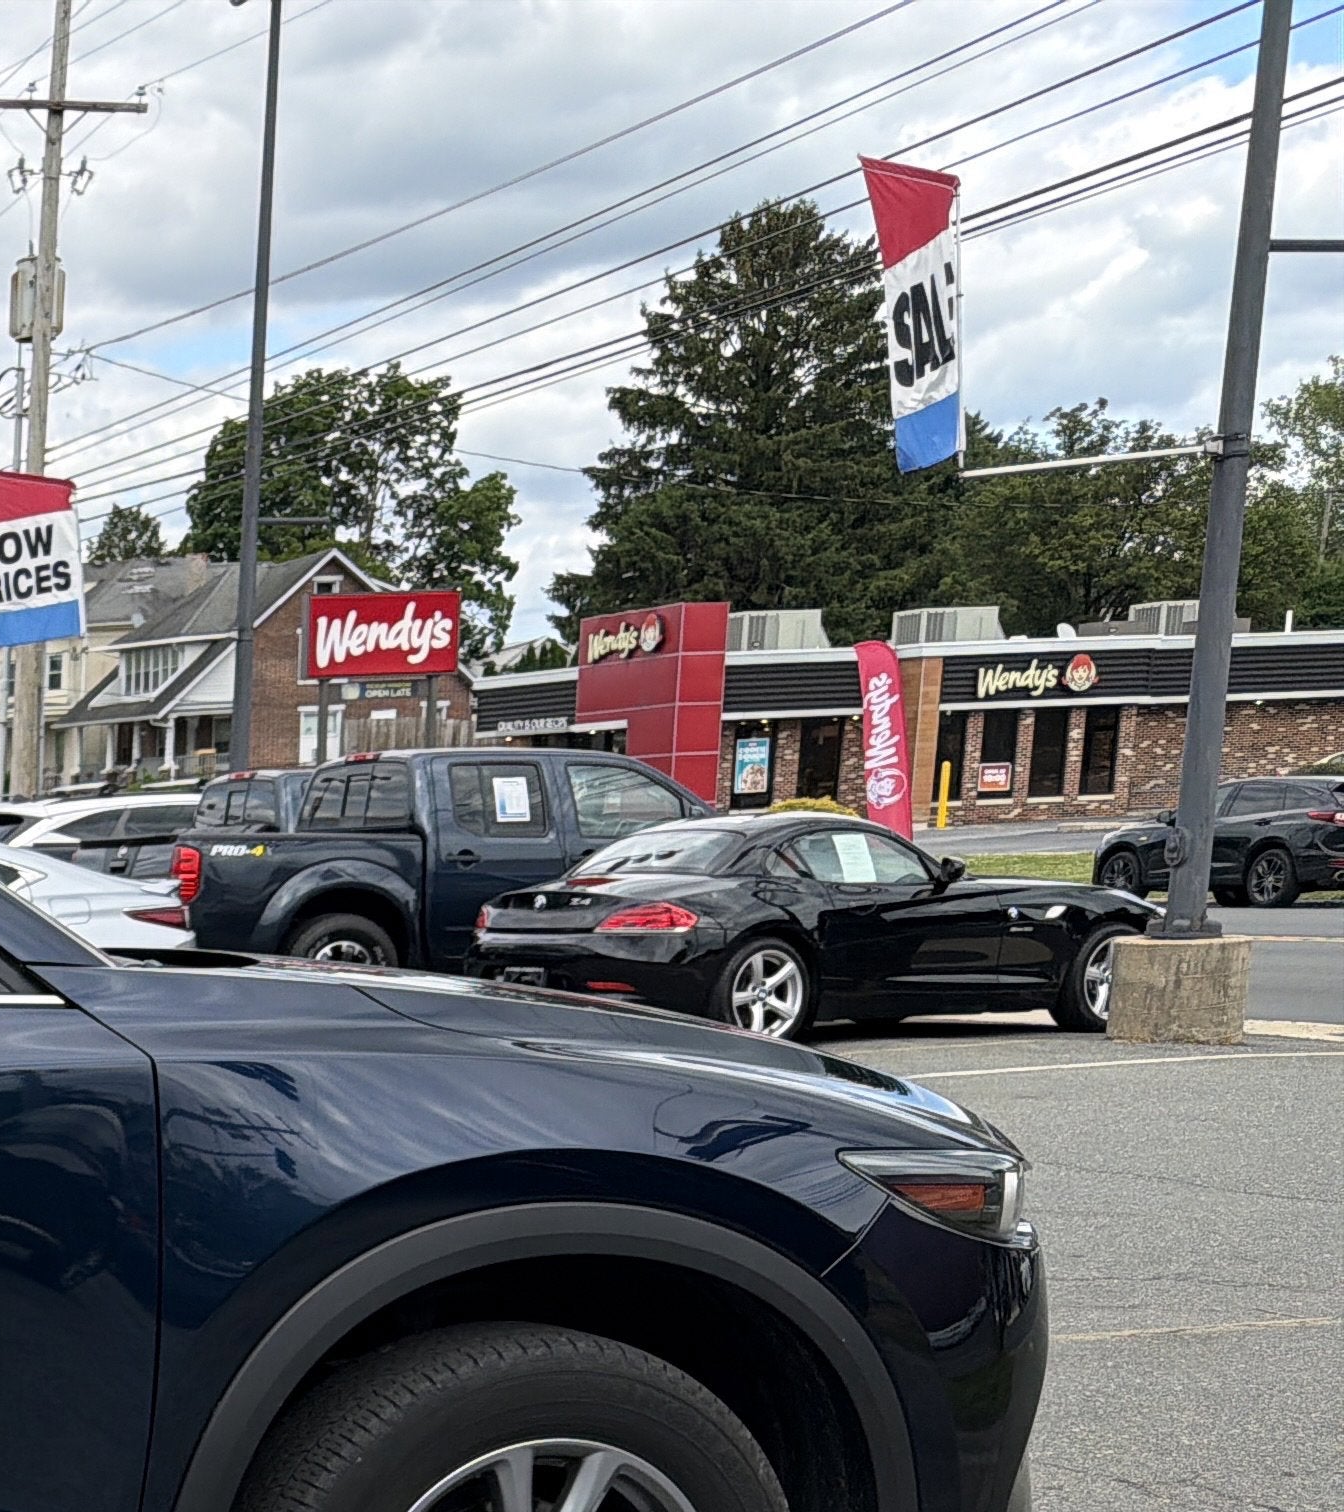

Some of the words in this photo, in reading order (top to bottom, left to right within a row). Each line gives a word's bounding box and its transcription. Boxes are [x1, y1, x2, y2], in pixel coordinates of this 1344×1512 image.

[315, 601, 454, 669] Wendy's
[588, 620, 639, 664] Wendy's
[977, 658, 1059, 699] Wendy's
[568, 897, 593, 906] Z4
